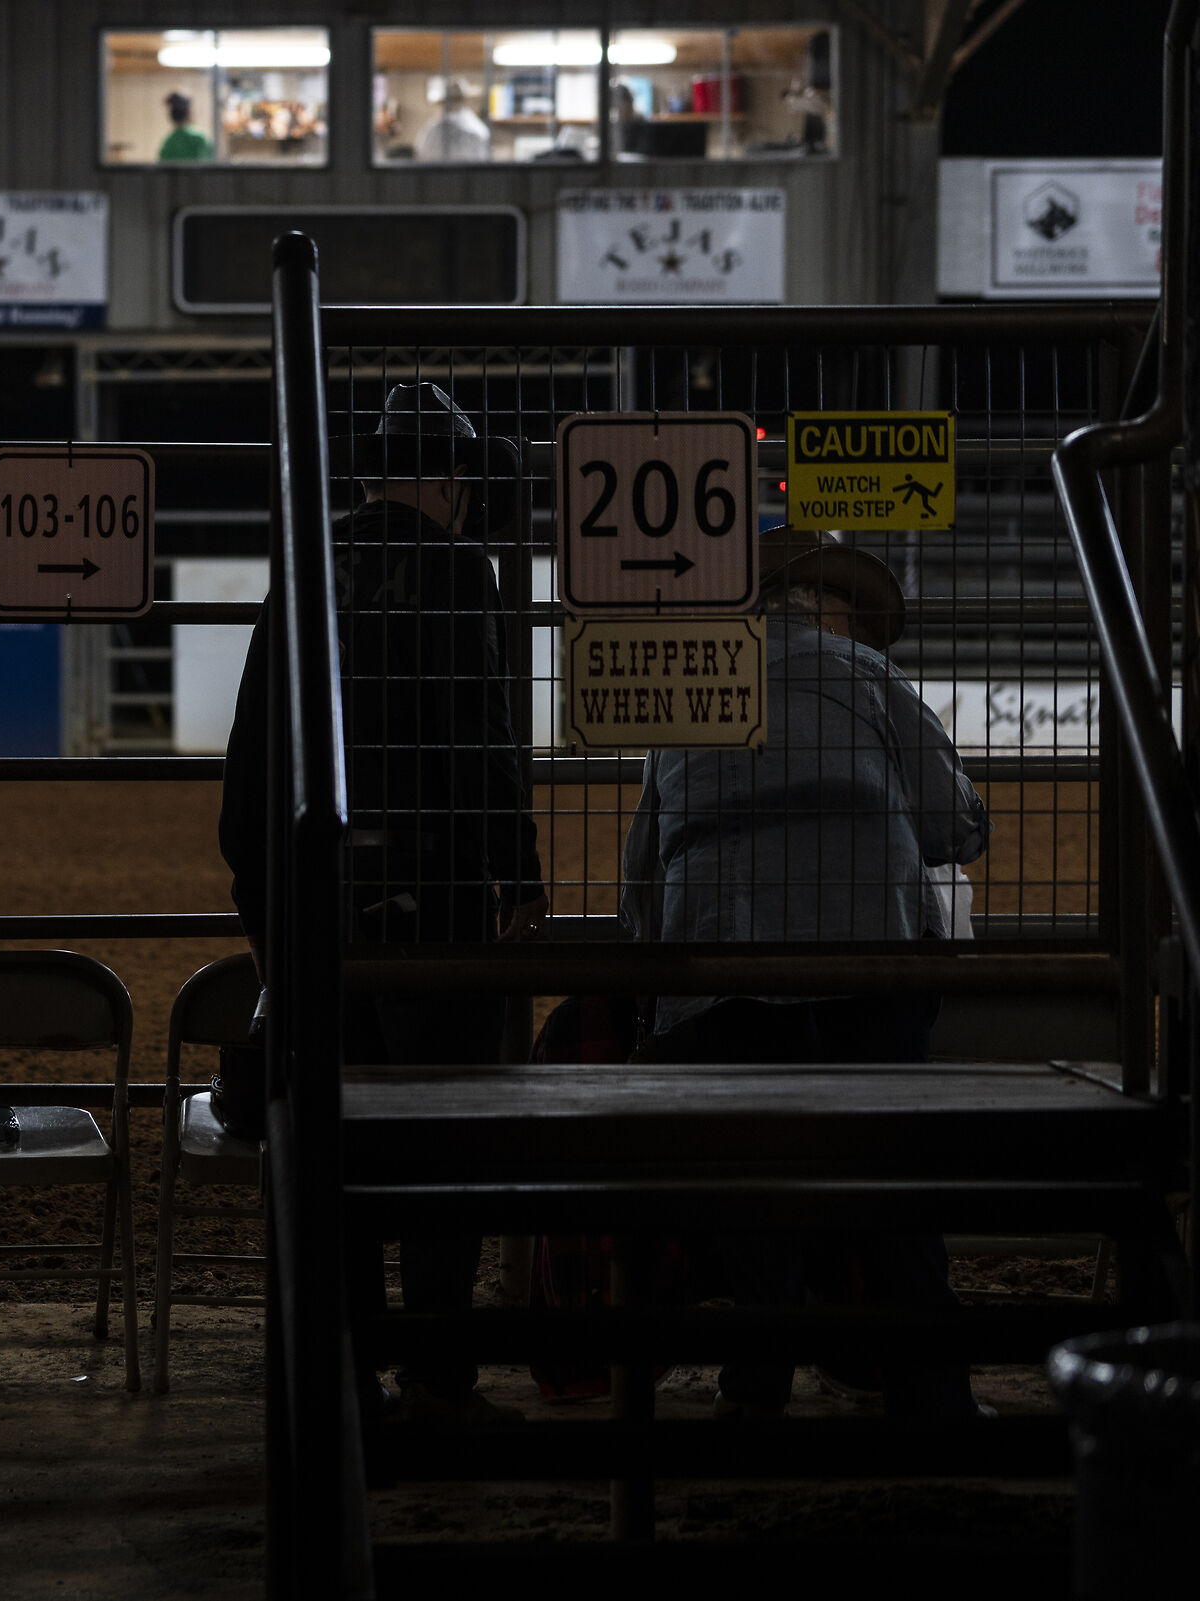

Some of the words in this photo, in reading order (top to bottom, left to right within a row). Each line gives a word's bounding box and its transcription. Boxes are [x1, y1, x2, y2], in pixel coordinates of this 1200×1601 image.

[800, 424, 946, 458] CAUTION
[579, 459, 736, 537] 206
[817, 475, 881, 493] WATCH
[1, 494, 139, 538] 103-106
[800, 500, 849, 518] YOUR
[852, 500, 896, 518] STEP
[588, 640, 743, 677] SLIPPERY
[580, 686, 673, 724] WHEN
[686, 686, 751, 724] WET
